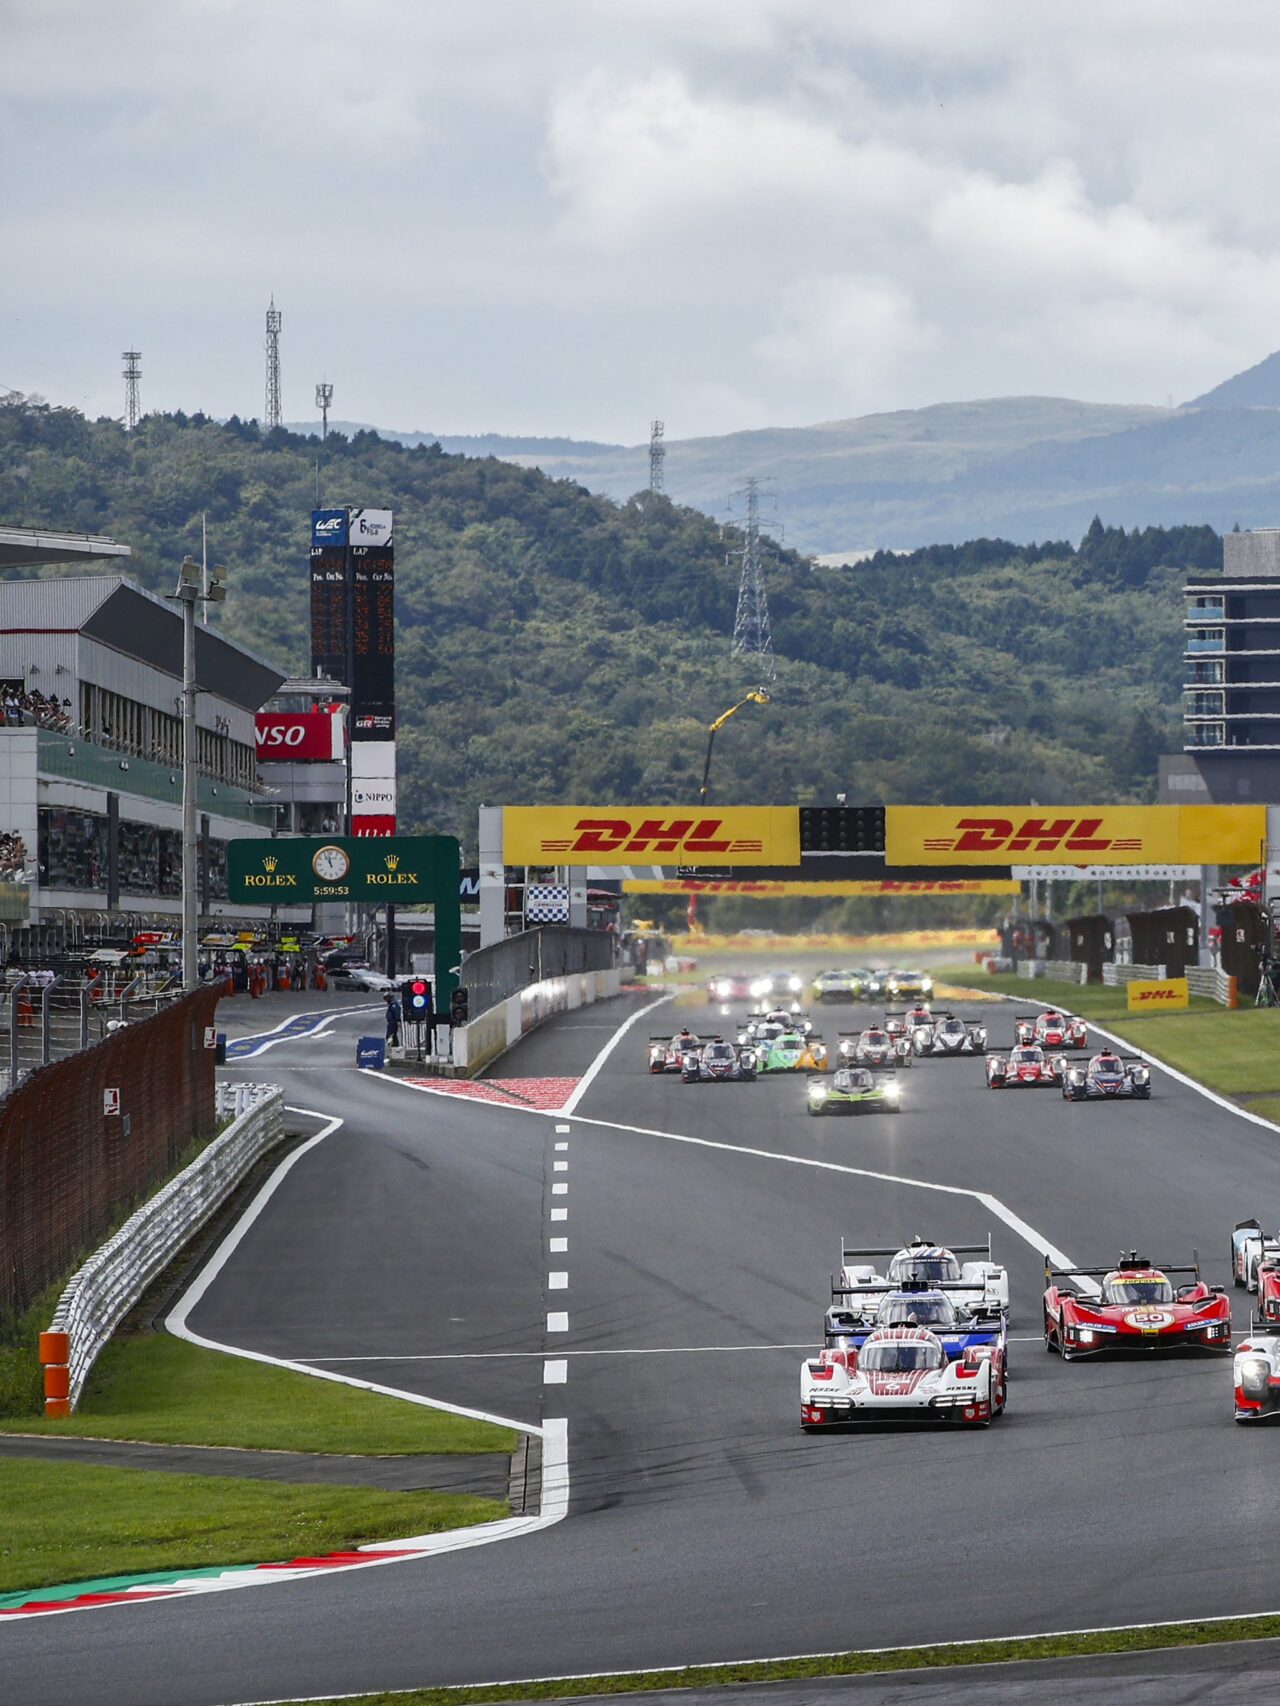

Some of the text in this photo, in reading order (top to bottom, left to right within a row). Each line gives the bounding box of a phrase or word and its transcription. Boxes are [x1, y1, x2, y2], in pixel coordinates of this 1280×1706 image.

[315, 518, 342, 530] WEC
[353, 547, 368, 555] LAP
[365, 793, 393, 801] NIPPO
[571, 820, 731, 851] DHL
[953, 819, 1112, 851] DHL
[244, 875, 297, 886] ROLEX
[366, 874, 418, 884] ROLEX
[313, 886, 349, 896] 5:59:53
[1139, 989, 1177, 1000] DHL
[1135, 1313, 1163, 1322] 50
